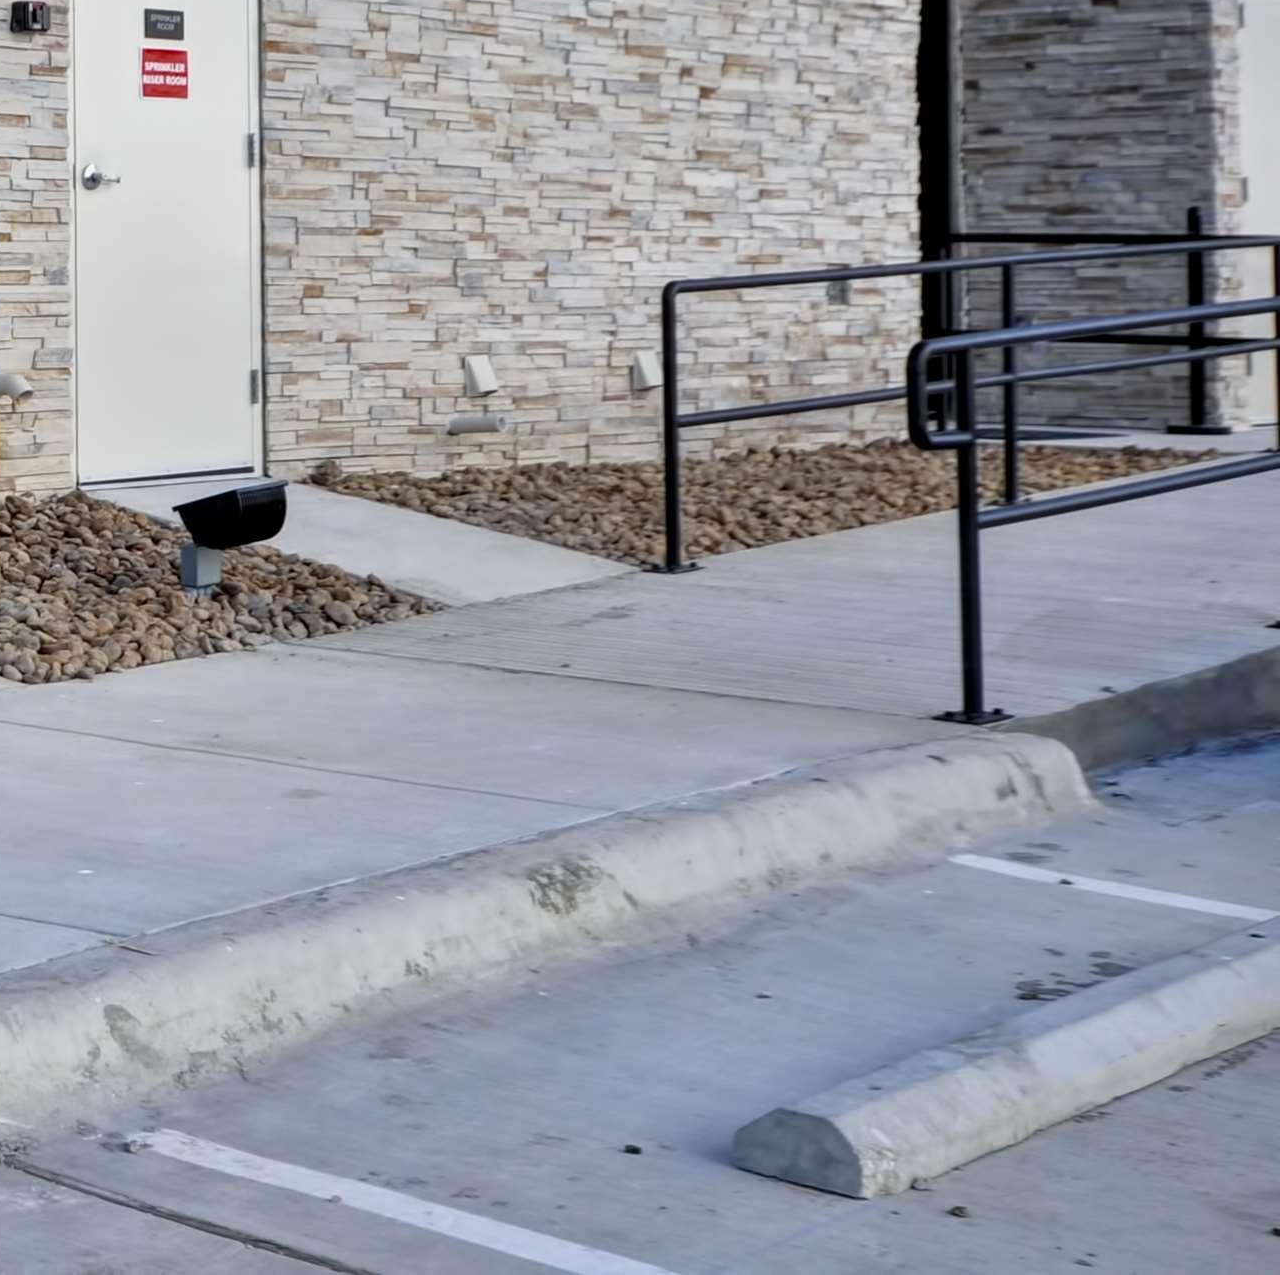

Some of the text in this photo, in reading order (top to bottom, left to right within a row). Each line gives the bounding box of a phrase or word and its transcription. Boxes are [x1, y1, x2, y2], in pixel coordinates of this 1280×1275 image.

[150, 13, 181, 23] SPRINKLER
[156, 22, 175, 30] ROOM
[144, 61, 186, 73] SPRINKLER
[165, 75, 187, 86] ROOM
